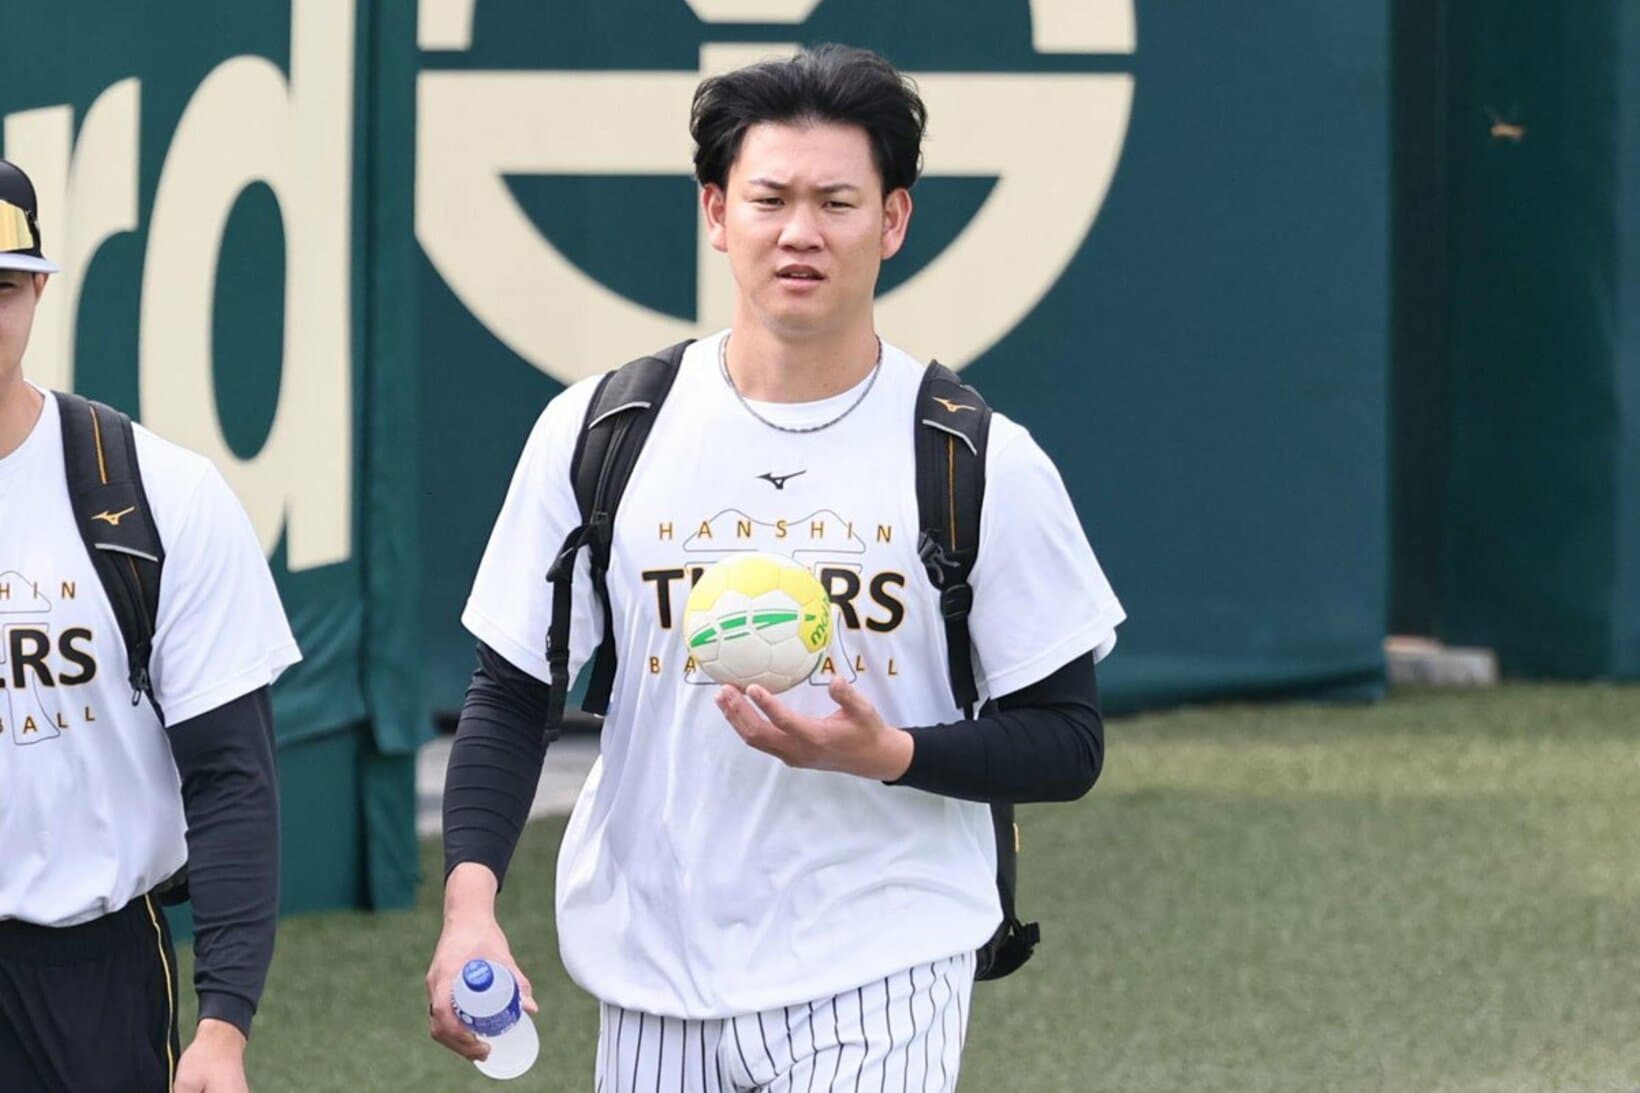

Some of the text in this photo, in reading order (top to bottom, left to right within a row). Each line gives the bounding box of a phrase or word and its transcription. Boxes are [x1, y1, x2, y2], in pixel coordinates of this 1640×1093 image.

[658, 519, 893, 544] HANSHIN
[641, 567, 906, 633] TRS
[0, 627, 97, 689] RS
[649, 654, 898, 677] BAALL
[0, 706, 96, 735] ALL
